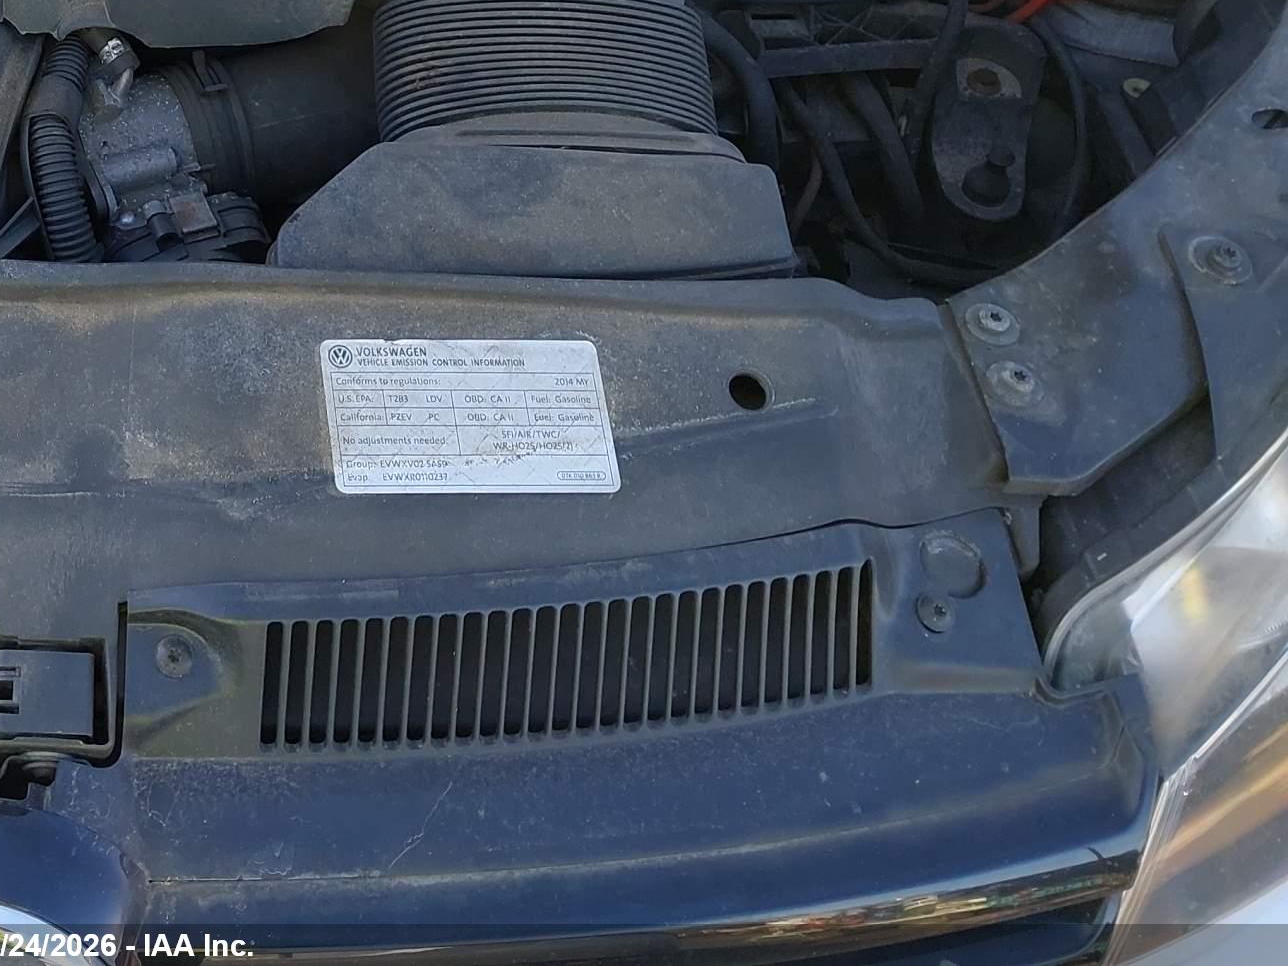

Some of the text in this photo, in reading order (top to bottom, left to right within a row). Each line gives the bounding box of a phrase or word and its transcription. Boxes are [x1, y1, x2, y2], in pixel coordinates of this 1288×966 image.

[356, 347, 427, 357] VOLKSWAGEN
[357, 358, 525, 367] VEHICLE EMISSION CONTROL INFORMATION
[336, 377, 441, 388] Conforms to regulations:
[555, 378, 589, 386] 2014 MY
[425, 394, 443, 403] LDV
[490, 395, 502, 404] CA
[555, 395, 591, 404] Gasoline
[340, 411, 384, 422] California:
[390, 413, 440, 421] PZEV PC
[493, 413, 506, 422] CA
[558, 413, 594, 422] Gasoline
[343, 436, 355, 445] No
[358, 436, 412, 446] adjustments
[346, 460, 377, 471] Group:
